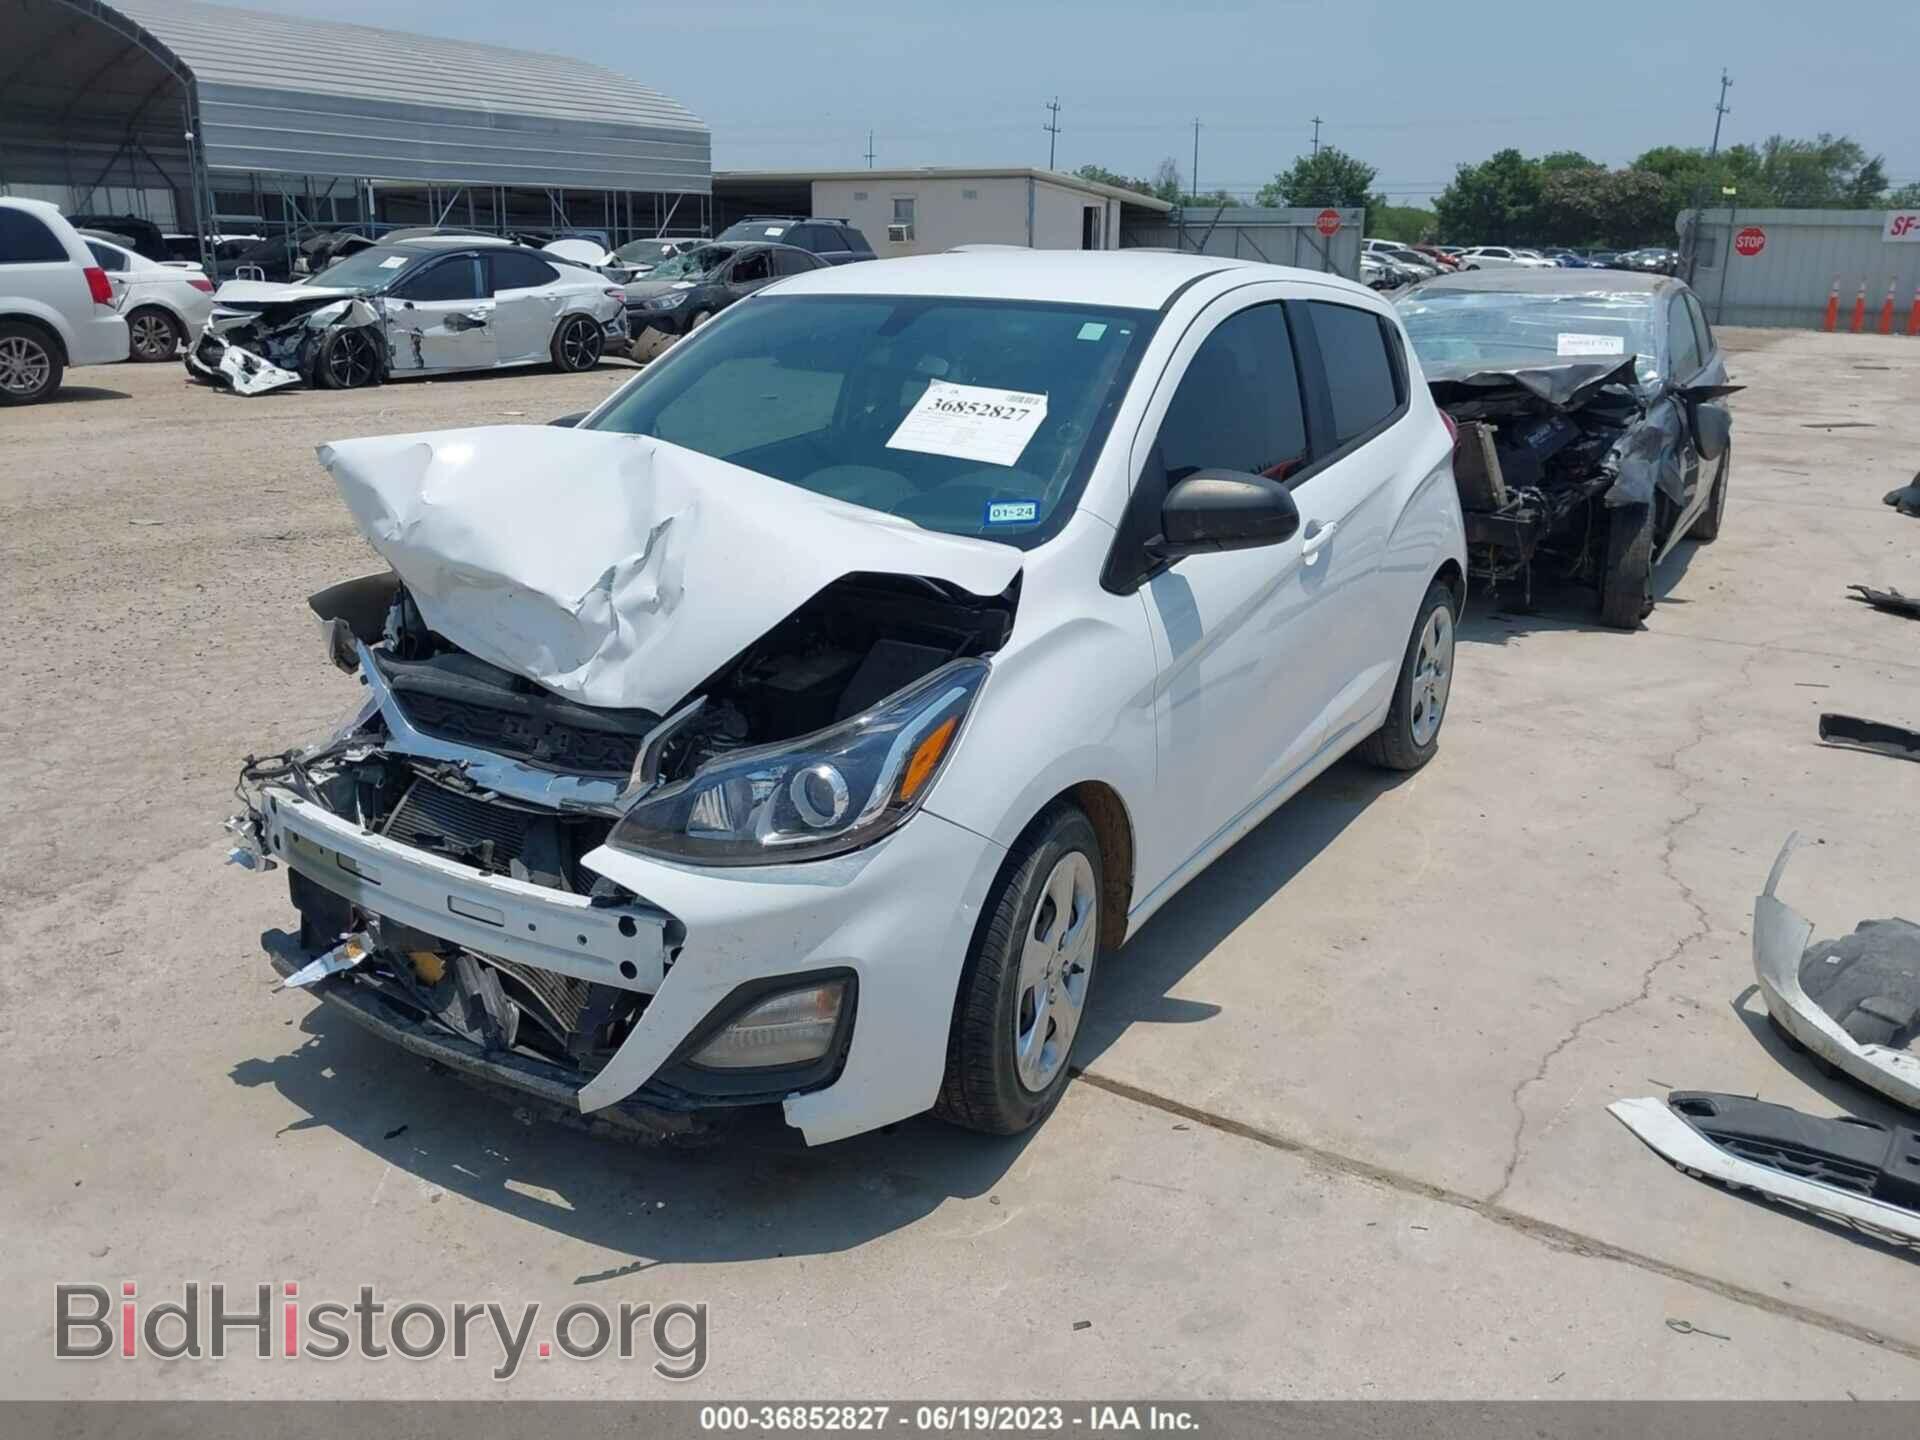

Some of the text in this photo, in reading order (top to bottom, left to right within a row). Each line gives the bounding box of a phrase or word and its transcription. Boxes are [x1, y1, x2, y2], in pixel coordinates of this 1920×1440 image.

[1736, 235, 1764, 248] STOP
[928, 398, 1031, 421] 36852827
[992, 507, 1033, 517] 01-24
